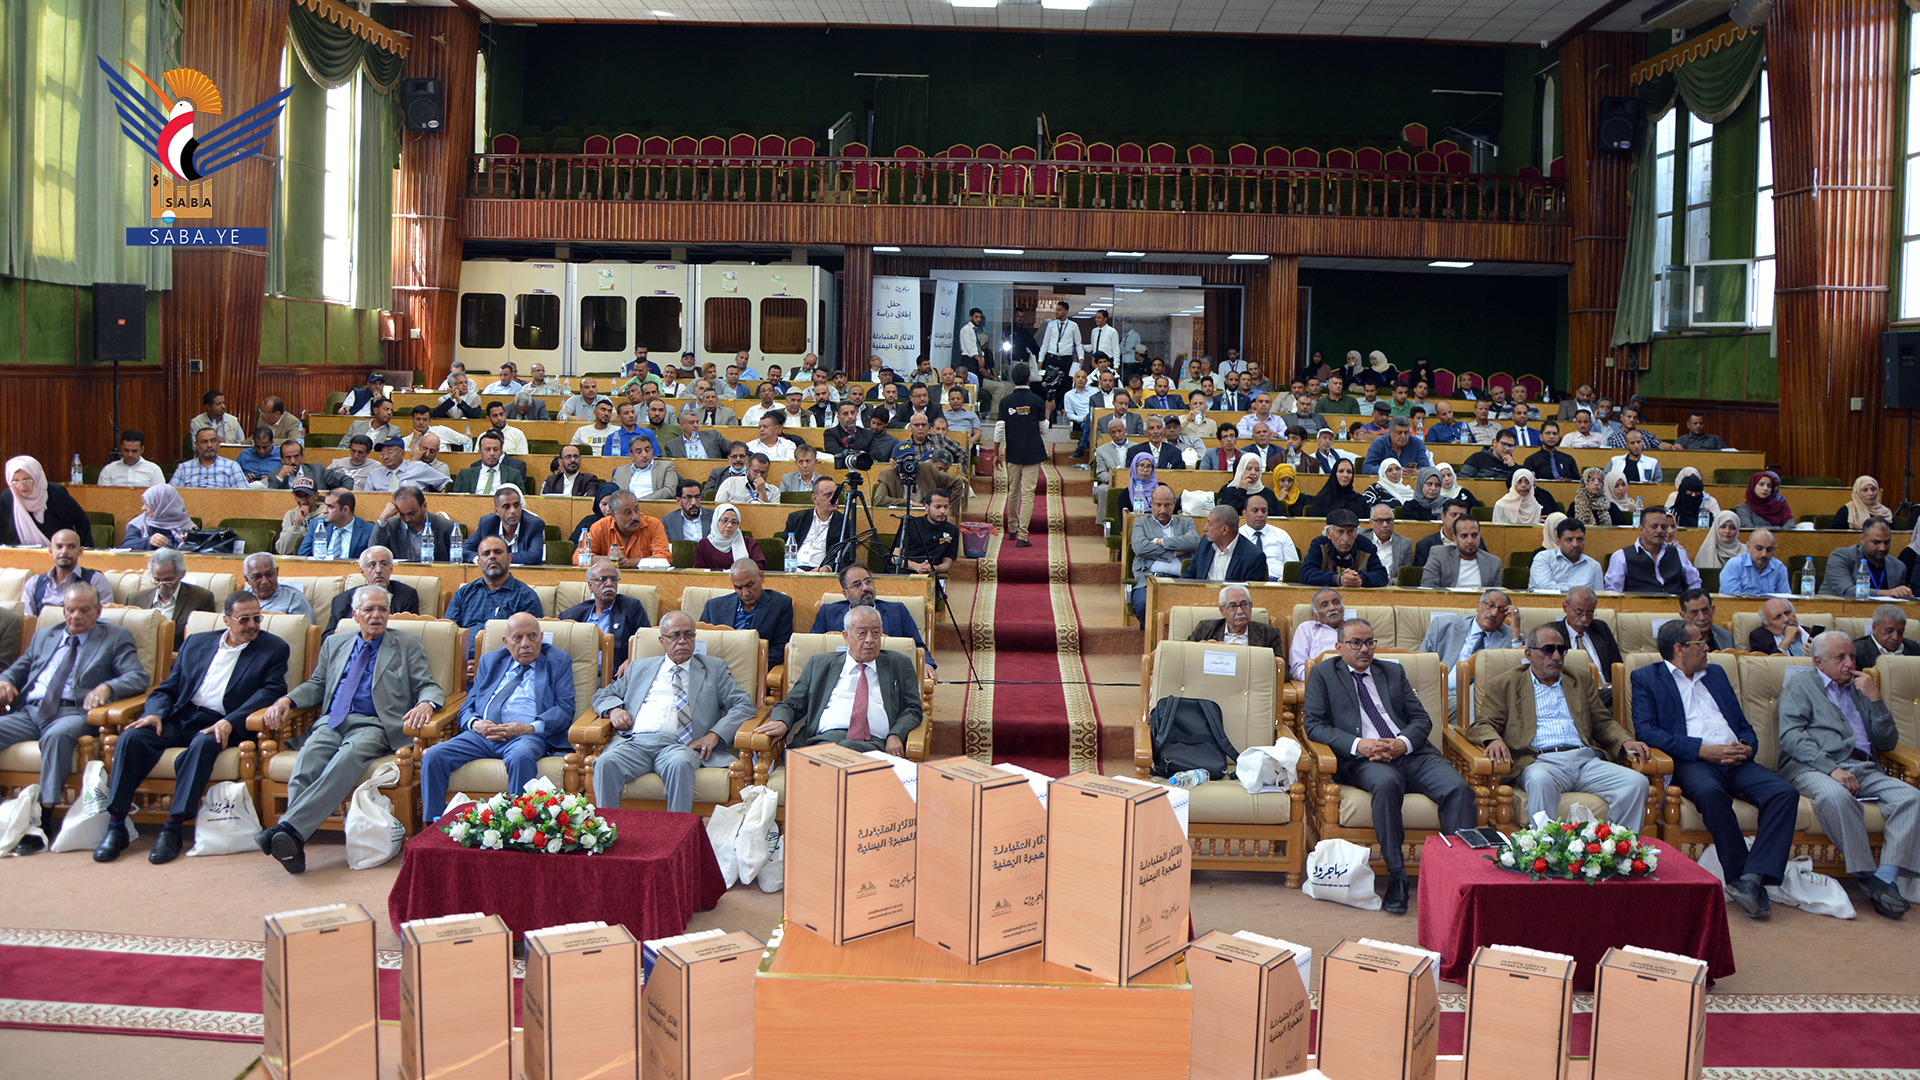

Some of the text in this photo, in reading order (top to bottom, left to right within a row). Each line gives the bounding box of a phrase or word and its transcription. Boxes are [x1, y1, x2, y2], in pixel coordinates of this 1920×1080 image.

[886, 300, 901, 309] حفل
[876, 309, 912, 321] إطلاق دراسة
[872, 332, 899, 341] المتبادلة
[871, 341, 915, 351] للهجرة اليمنية
[858, 822, 897, 839] المتبادلة
[857, 831, 917, 854] للهجرة اليمنية
[993, 838, 1032, 855] المتبادلة
[992, 854, 1023, 872] اليمنية
[1139, 850, 1168, 871] المتبادلة
[1138, 858, 1183, 888] للهجرة اليمنية
